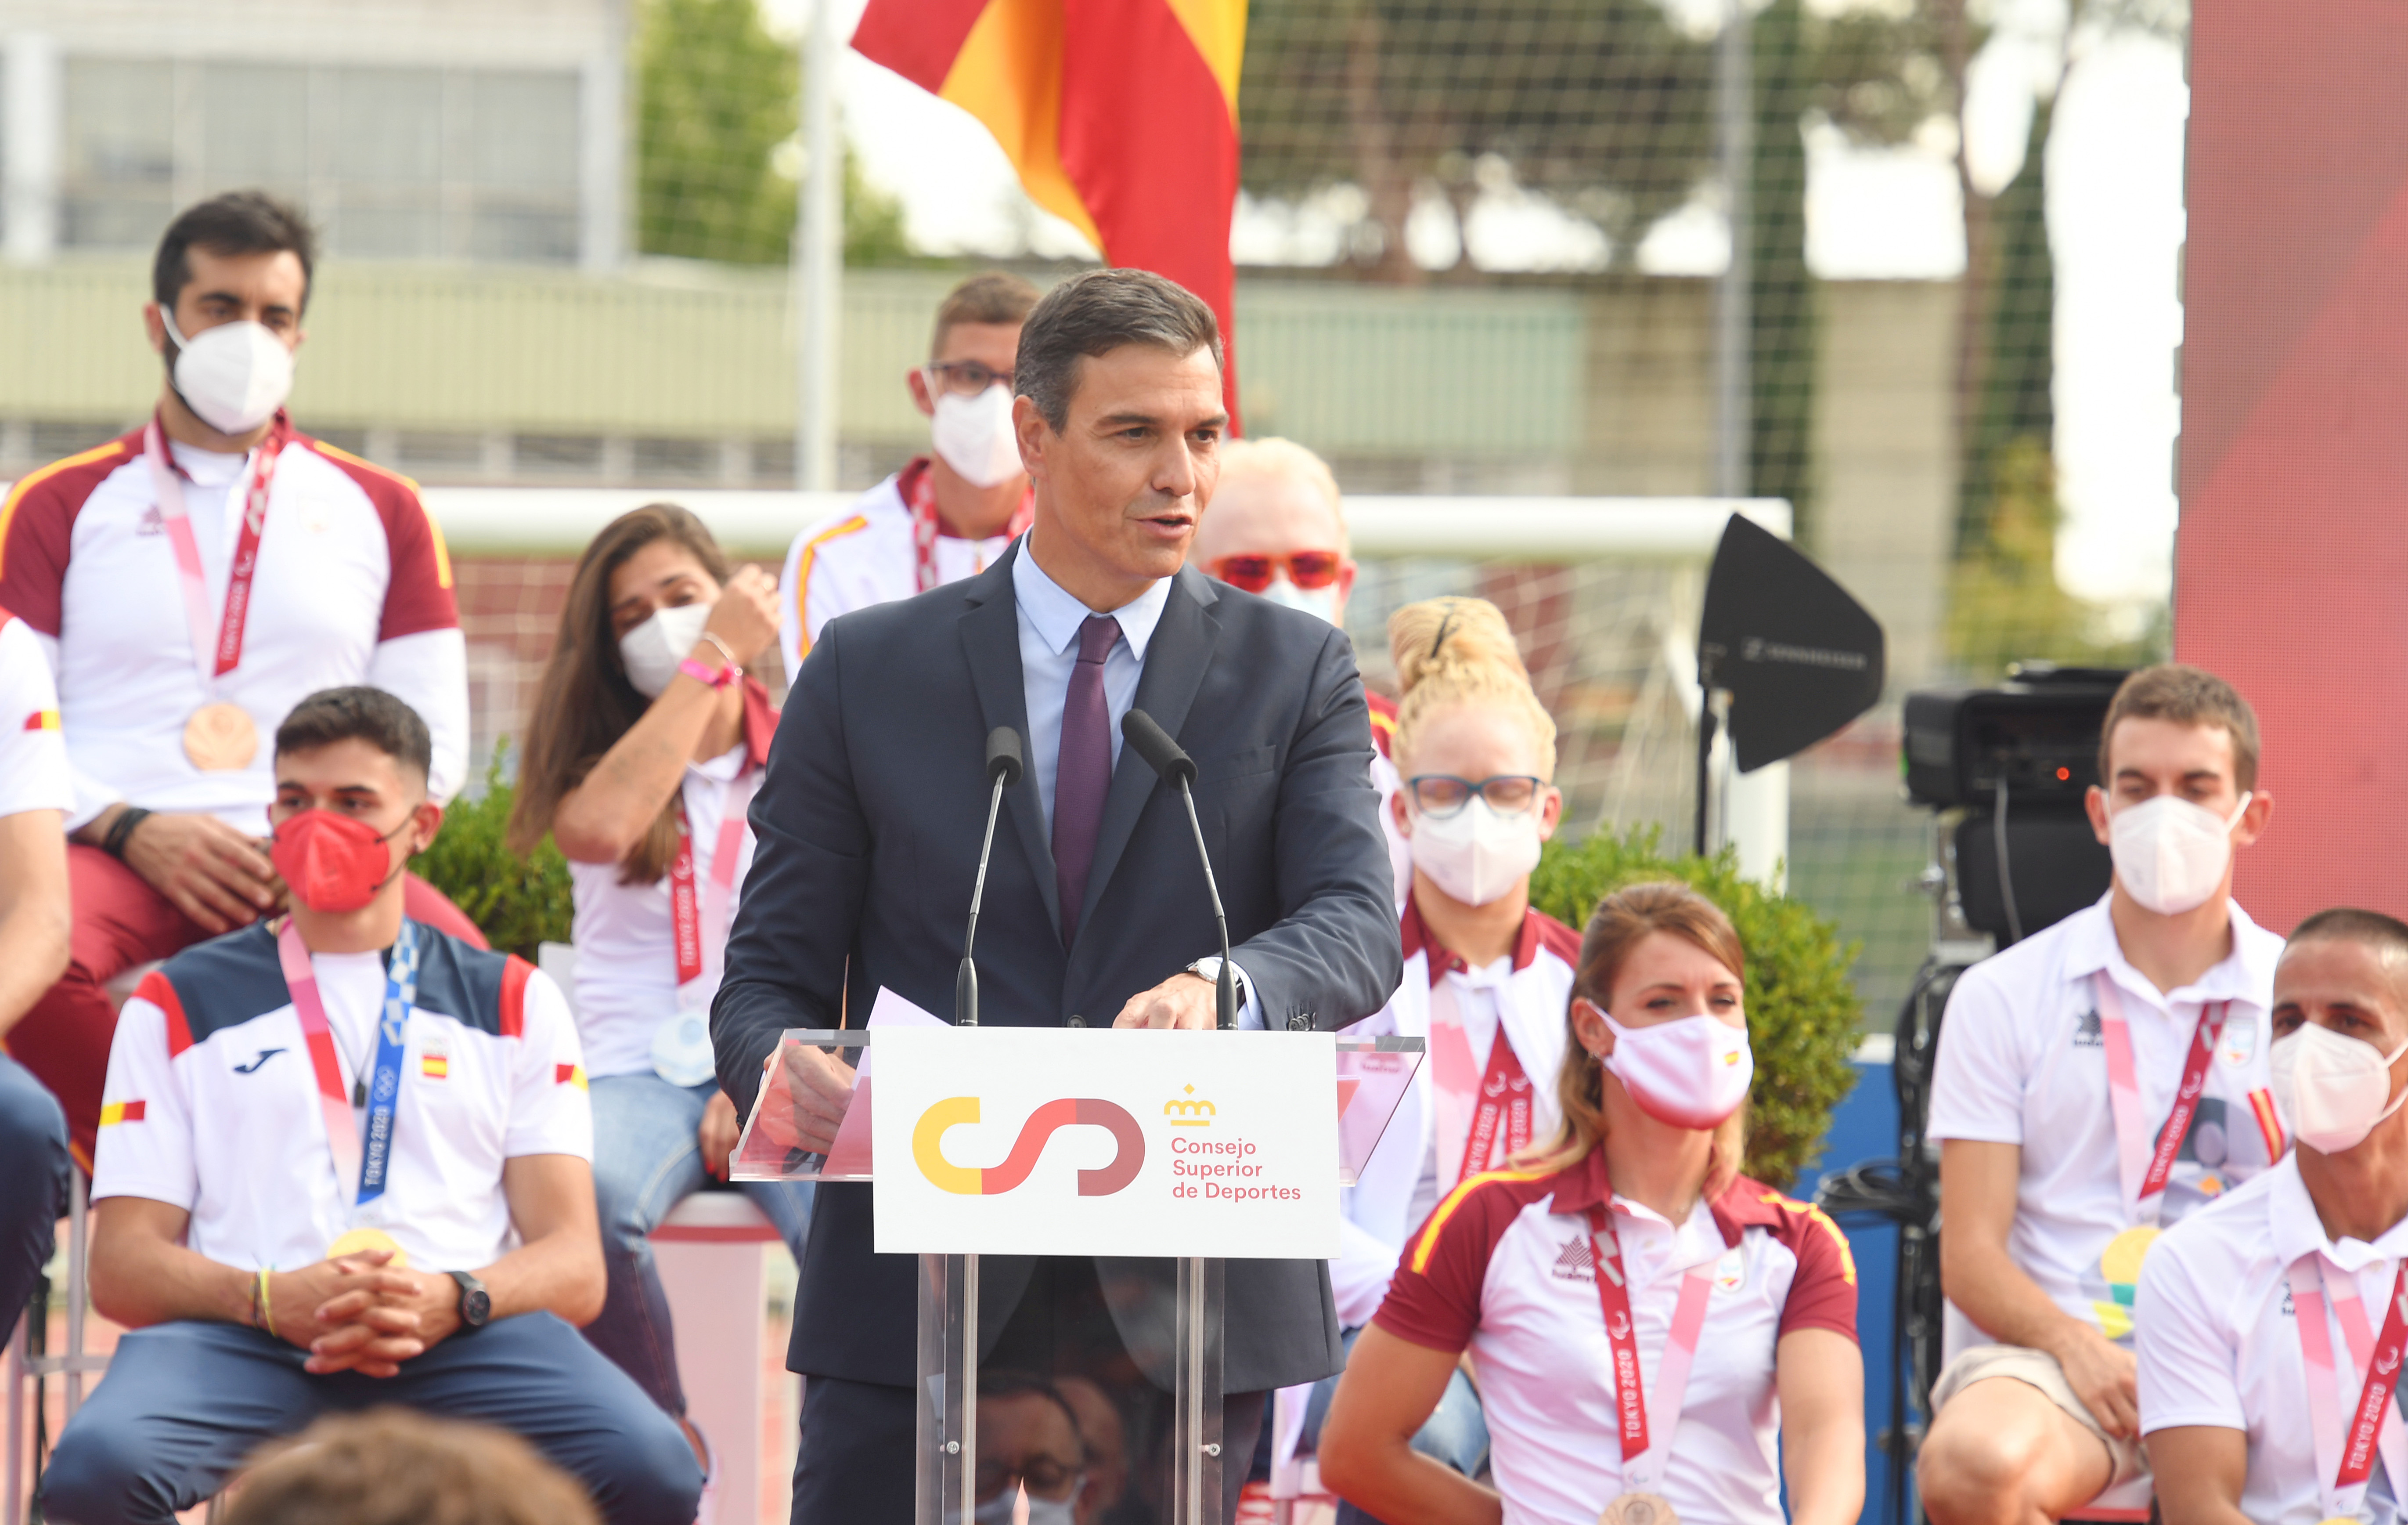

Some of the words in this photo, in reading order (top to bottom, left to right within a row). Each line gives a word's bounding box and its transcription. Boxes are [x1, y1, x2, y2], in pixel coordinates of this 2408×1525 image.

[676, 885, 695, 921] 2020
[679, 923, 697, 966] TOKYO
[371, 1105, 390, 1141] 2020
[1475, 1103, 1498, 1140] 2020
[1510, 1099, 1528, 1136] 2020
[364, 1141, 386, 1186] TOKYO
[1171, 1137, 1256, 1159] Consejo
[1464, 1140, 1489, 1179] OKYO
[2147, 1141, 2175, 1184] TOKYO
[2165, 1105, 2189, 1141] 2020
[1173, 1160, 1262, 1180] Superior
[1172, 1182, 1198, 1198] de
[1205, 1182, 1301, 1203] Deportes
[1617, 1348, 1636, 1388] 2020
[1622, 1389, 1642, 1440] TOKYO
[2347, 1421, 2375, 1469] TOKYO
[2362, 1383, 2386, 1423] 2020
